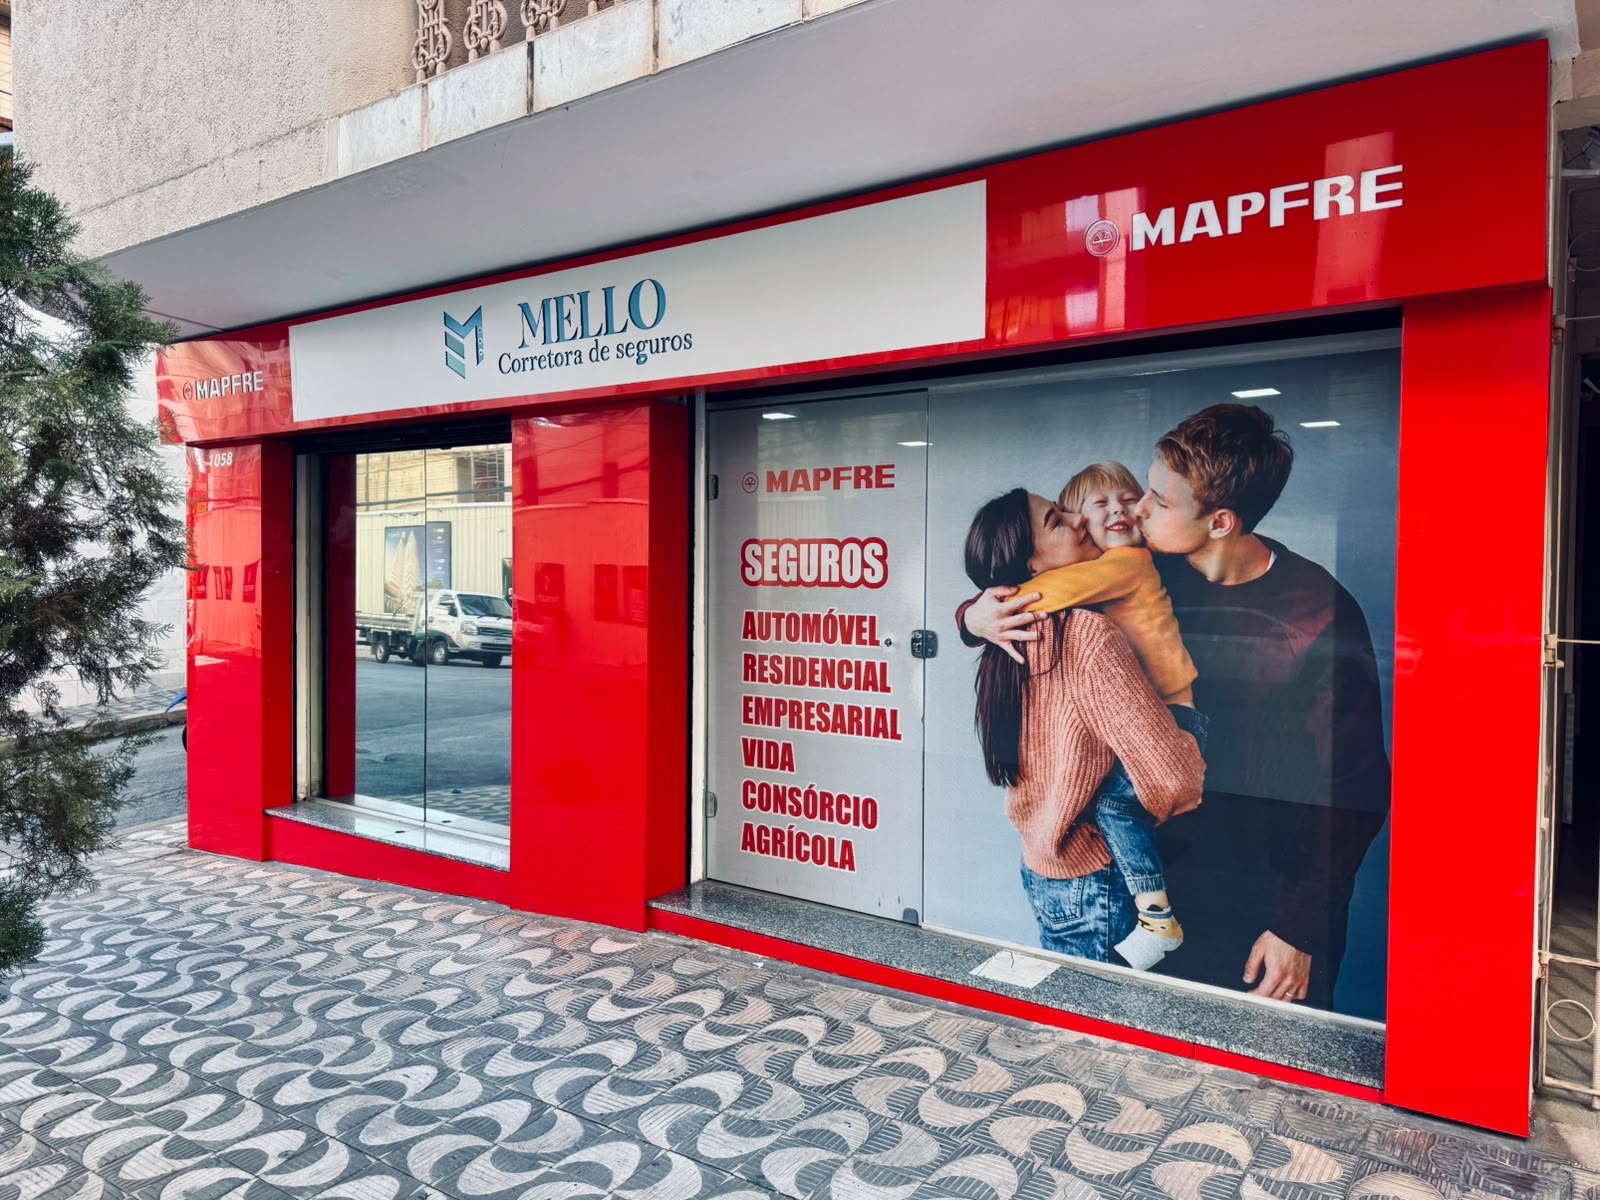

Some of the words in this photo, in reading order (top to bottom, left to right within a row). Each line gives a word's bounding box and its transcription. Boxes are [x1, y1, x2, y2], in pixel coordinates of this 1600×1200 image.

[1131, 164, 1404, 251] MAPFRE
[517, 278, 667, 349] MELLO
[498, 348, 584, 375] Corretora
[588, 338, 610, 363] de
[615, 332, 693, 366] seguros
[195, 371, 264, 400] MAPFRE
[209, 452, 233, 468] 1058
[766, 463, 896, 493] MAPFRE
[743, 541, 885, 585] SEGUROS
[742, 608, 881, 647] AUTOMÓVEL
[742, 653, 892, 693] RESIDENCIAL
[742, 695, 902, 741] EMPRESARIAL
[741, 737, 796, 773] VIDA
[741, 779, 879, 830] CONSÓRCIO
[740, 822, 857, 872] AGRÍCOLA
